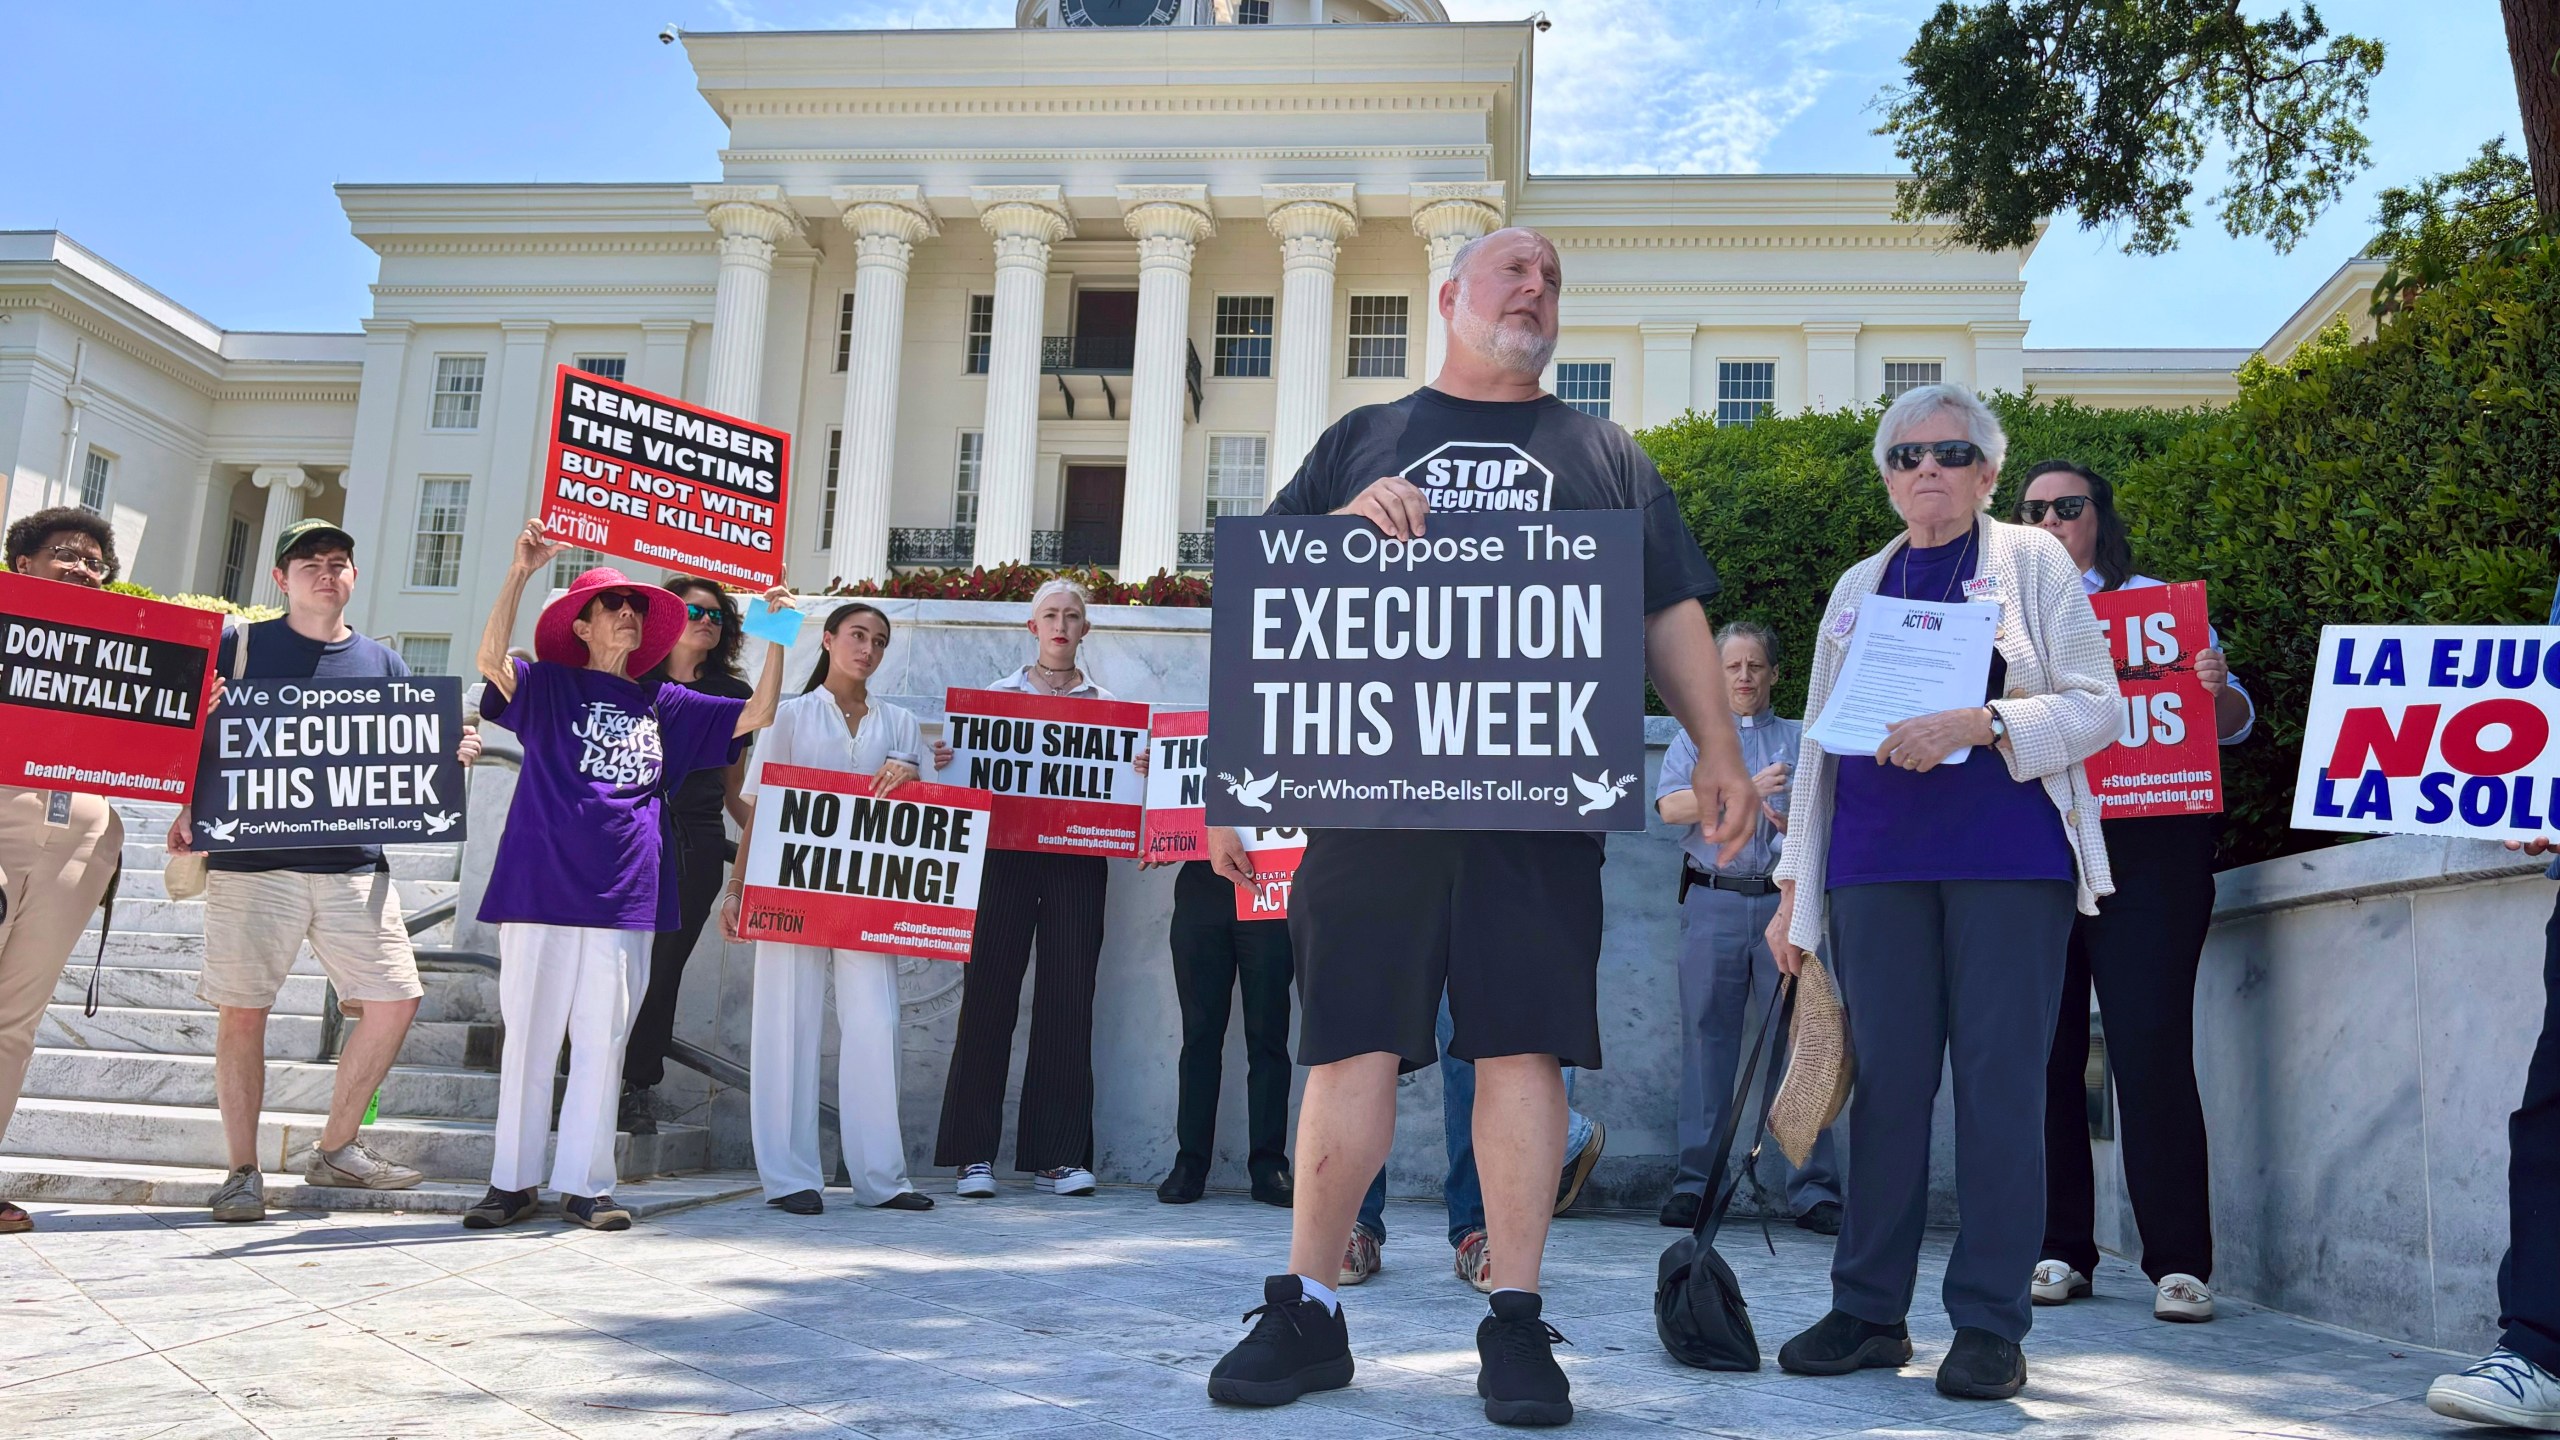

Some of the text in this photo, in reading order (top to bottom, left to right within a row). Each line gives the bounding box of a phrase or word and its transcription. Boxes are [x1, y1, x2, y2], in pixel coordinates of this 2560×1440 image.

[571, 382, 775, 464] REMEMBER
[568, 415, 775, 494] THE VICTIMS
[1425, 458, 1529, 490] STOP
[561, 449, 774, 527] BUT NOT WITH
[1419, 487, 1539, 512] XECUTIONS
[545, 511, 609, 546] ACTION
[552, 504, 610, 525] DEATH PENALTY
[557, 478, 772, 553] MORE KILLING
[634, 538, 774, 587] DeathPenaltyAction.org
[1259, 525, 1597, 573] We Oppose The
[1252, 584, 1602, 660] EXECUTION
[1901, 614, 1943, 632] ACTION
[2125, 611, 2180, 667] IS
[5, 623, 152, 676] DON'T KILL
[2332, 638, 2407, 687] LA
[9, 665, 151, 714] MENTALLY
[154, 687, 191, 721] ILL
[223, 682, 436, 710] We Oppose The
[219, 713, 440, 759] EXECUTION
[949, 715, 1139, 763] THOU SHALT
[1253, 681, 1600, 757] THIS WEEK
[2325, 698, 2550, 779] NO
[24, 760, 186, 794] DeathPenaltyAction.org
[579, 739, 660, 788] People
[969, 756, 1114, 800] NOT KILL!
[2101, 770, 2213, 789] #StopExecutions
[220, 764, 440, 811] THIS WEEK
[1280, 778, 1569, 806] ForWhomTheBellsToll.org
[2312, 767, 2560, 831] LA SOL
[239, 817, 422, 835] ForWhomTheBellsToll.org
[779, 788, 973, 854] NO MORE
[1037, 834, 1135, 852] DeathPenaltyAction.org
[1066, 824, 1136, 839] #StopExecutions
[1150, 834, 1197, 852] ACTION
[777, 842, 961, 906] KILLING!
[1255, 871, 1286, 881] DEATH
[748, 911, 804, 934] ACTION
[861, 930, 970, 953] DeathPenaltyAction.org
[893, 921, 972, 939] #StopExecutions
